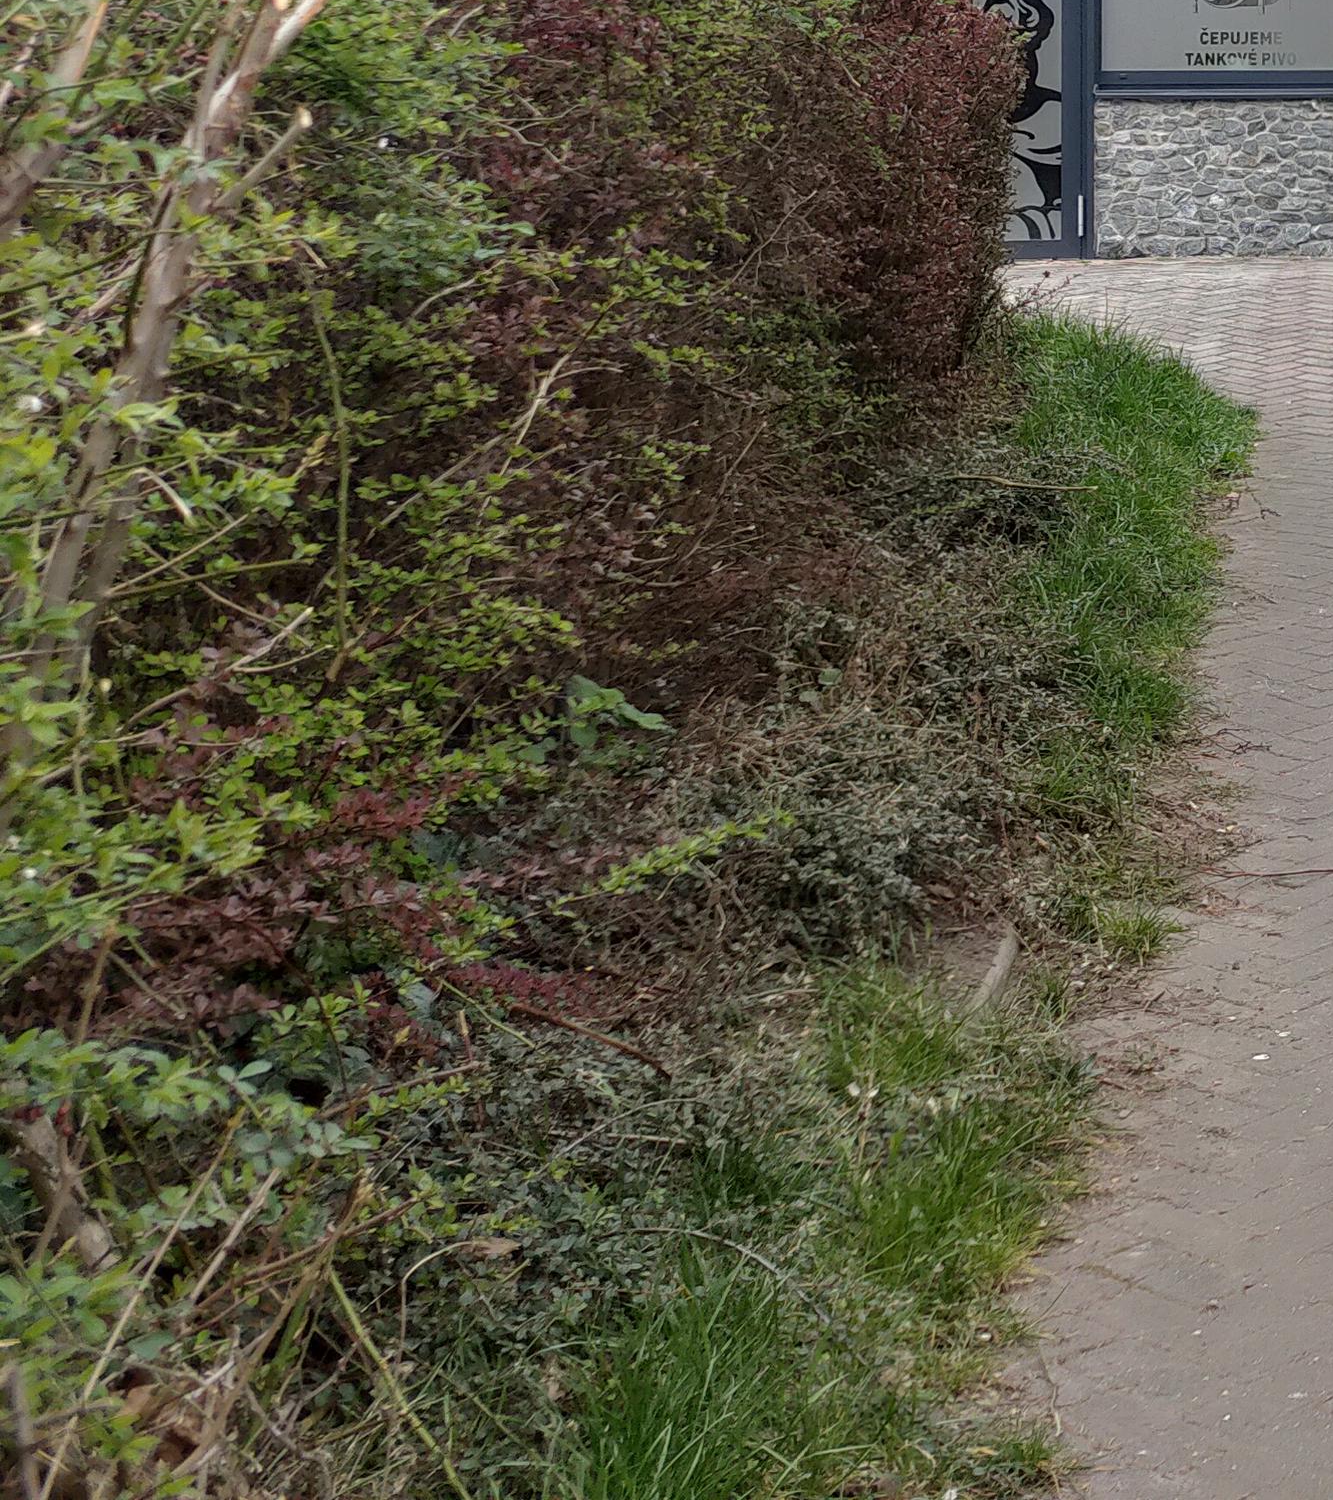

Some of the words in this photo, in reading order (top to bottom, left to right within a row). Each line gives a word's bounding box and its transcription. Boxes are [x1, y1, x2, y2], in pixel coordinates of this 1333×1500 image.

[1200, 27, 1283, 45] ČEPUJEME
[1185, 48, 1258, 66] TANKOVÉ
[1261, 52, 1297, 66] PIVO
